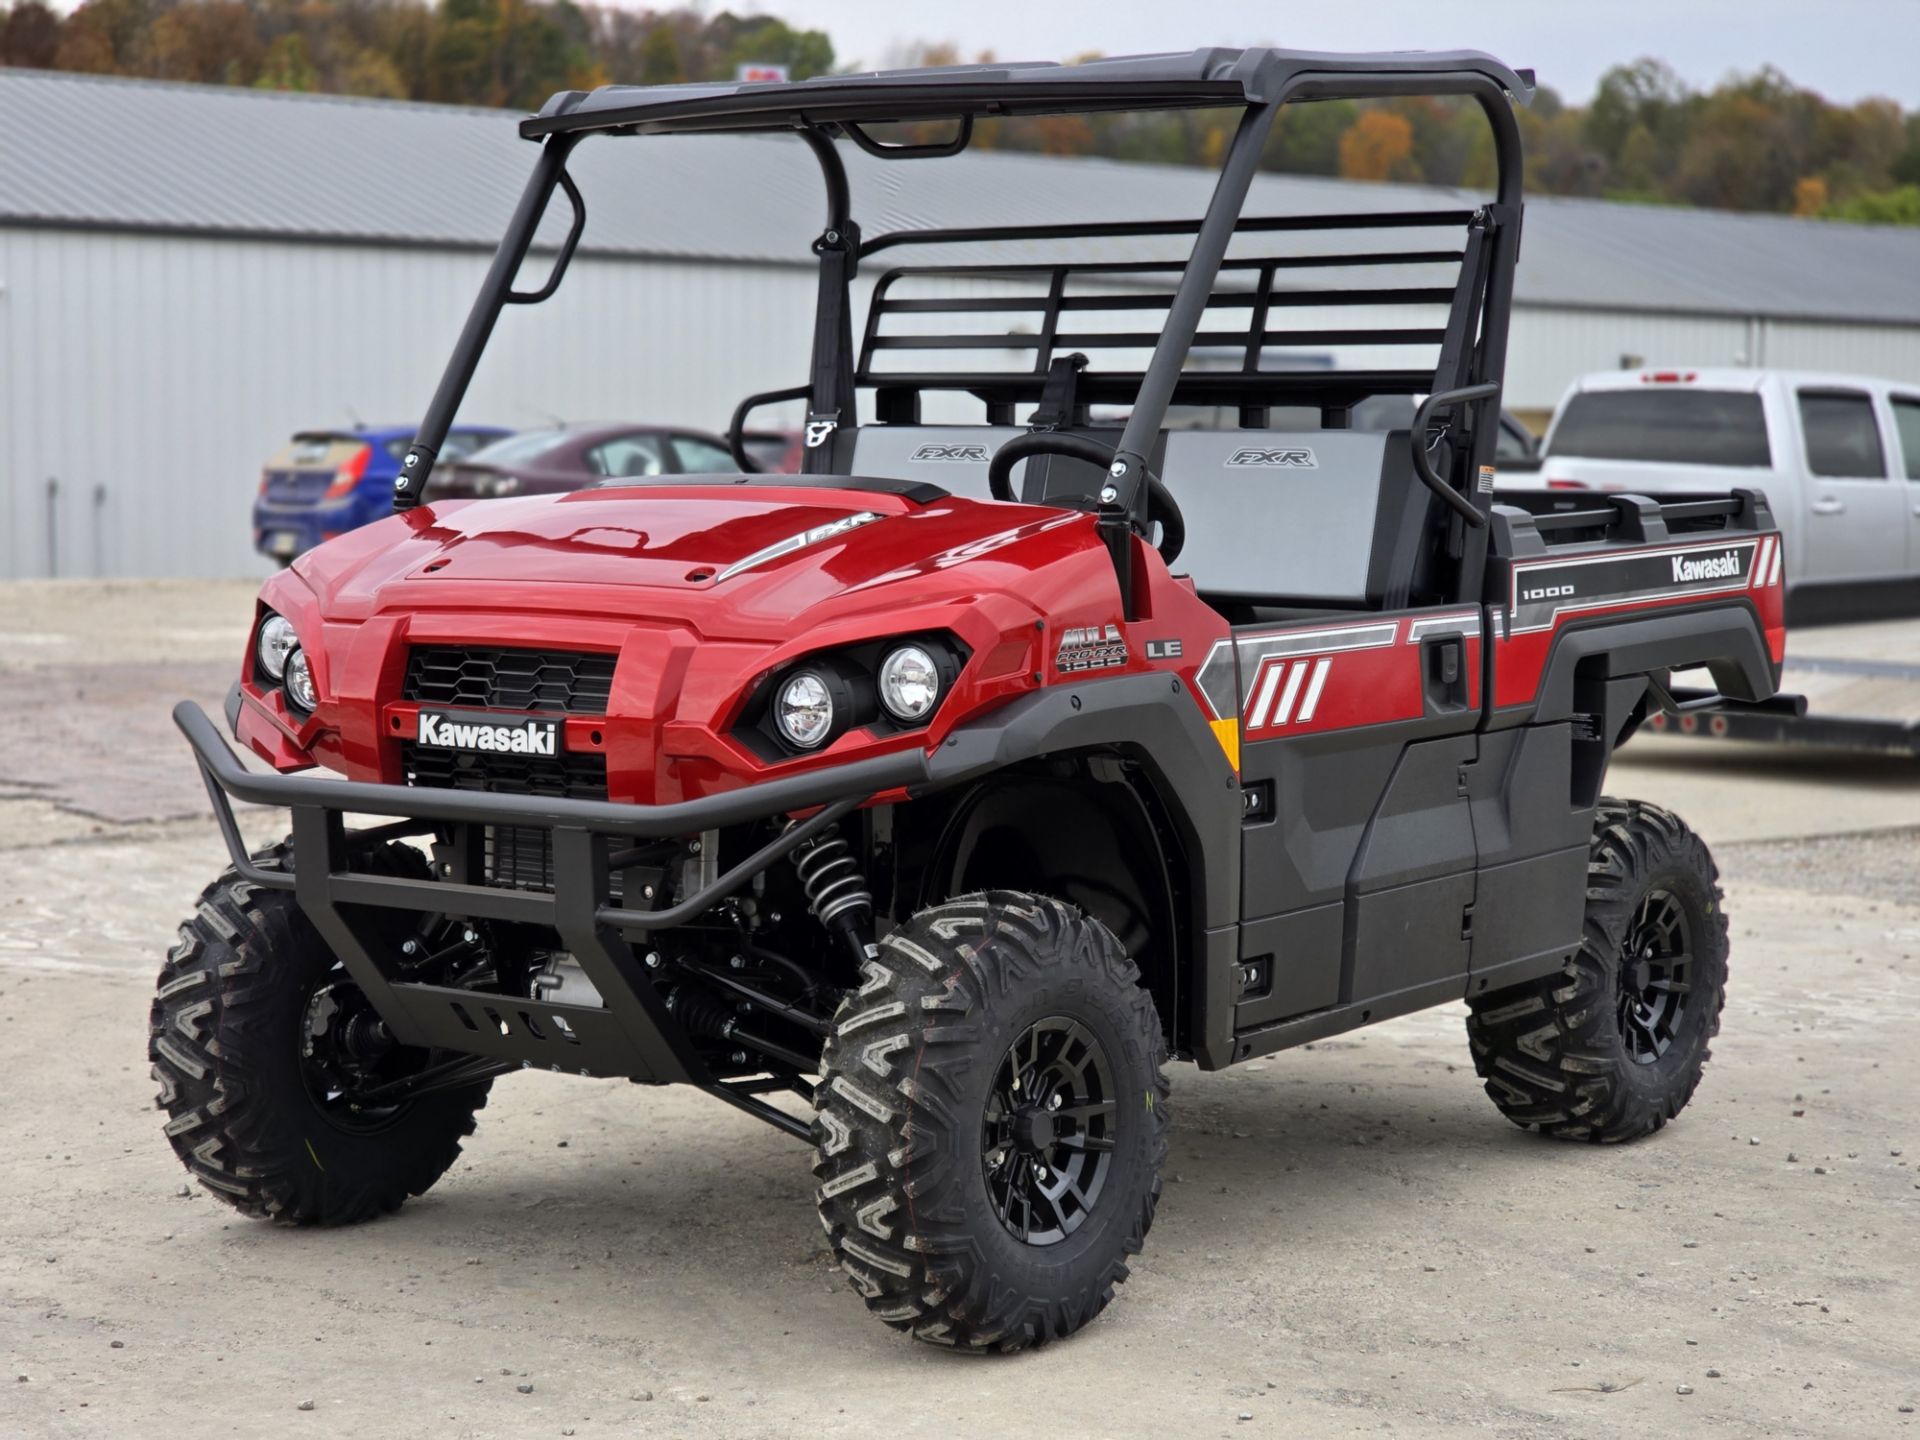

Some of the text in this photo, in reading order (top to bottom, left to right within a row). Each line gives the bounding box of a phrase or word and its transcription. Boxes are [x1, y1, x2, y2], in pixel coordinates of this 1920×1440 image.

[1671, 551, 1740, 582] Kawasaki
[1523, 585, 1575, 600] 1000
[1060, 624, 1124, 652] MULE
[1147, 641, 1182, 658] LE
[419, 713, 556, 755] Kawasaki
